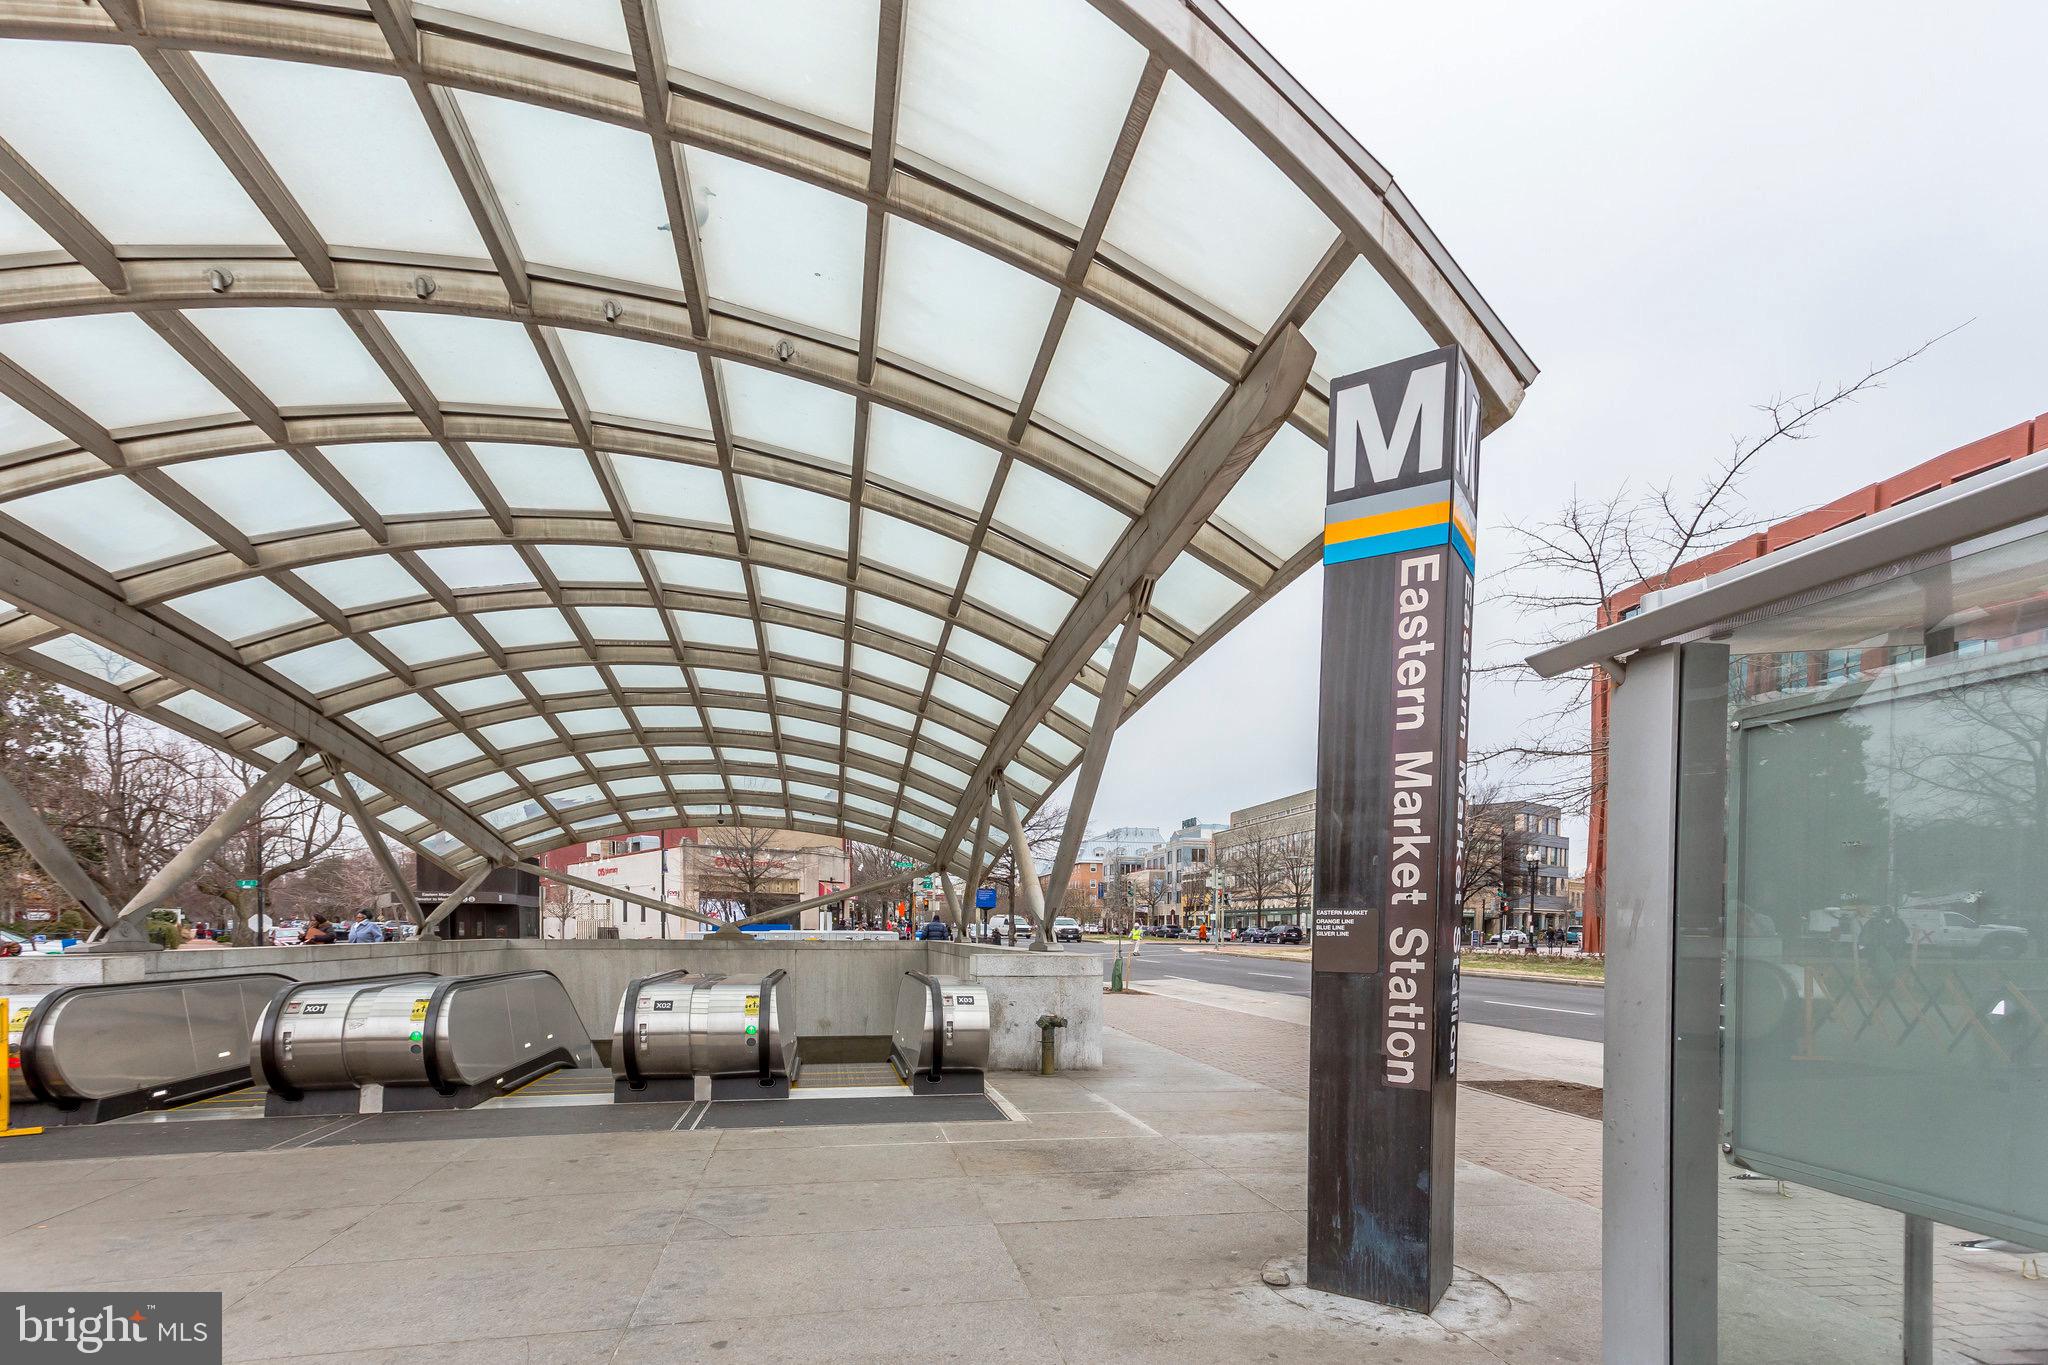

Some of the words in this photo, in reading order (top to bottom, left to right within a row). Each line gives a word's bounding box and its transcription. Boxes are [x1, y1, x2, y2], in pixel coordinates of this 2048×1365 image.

[1334, 362, 1447, 492] M
[1455, 362, 1478, 502] M
[1395, 554, 1440, 731] Eastern
[1391, 751, 1433, 905] Market
[1386, 928, 1429, 1084] Station
